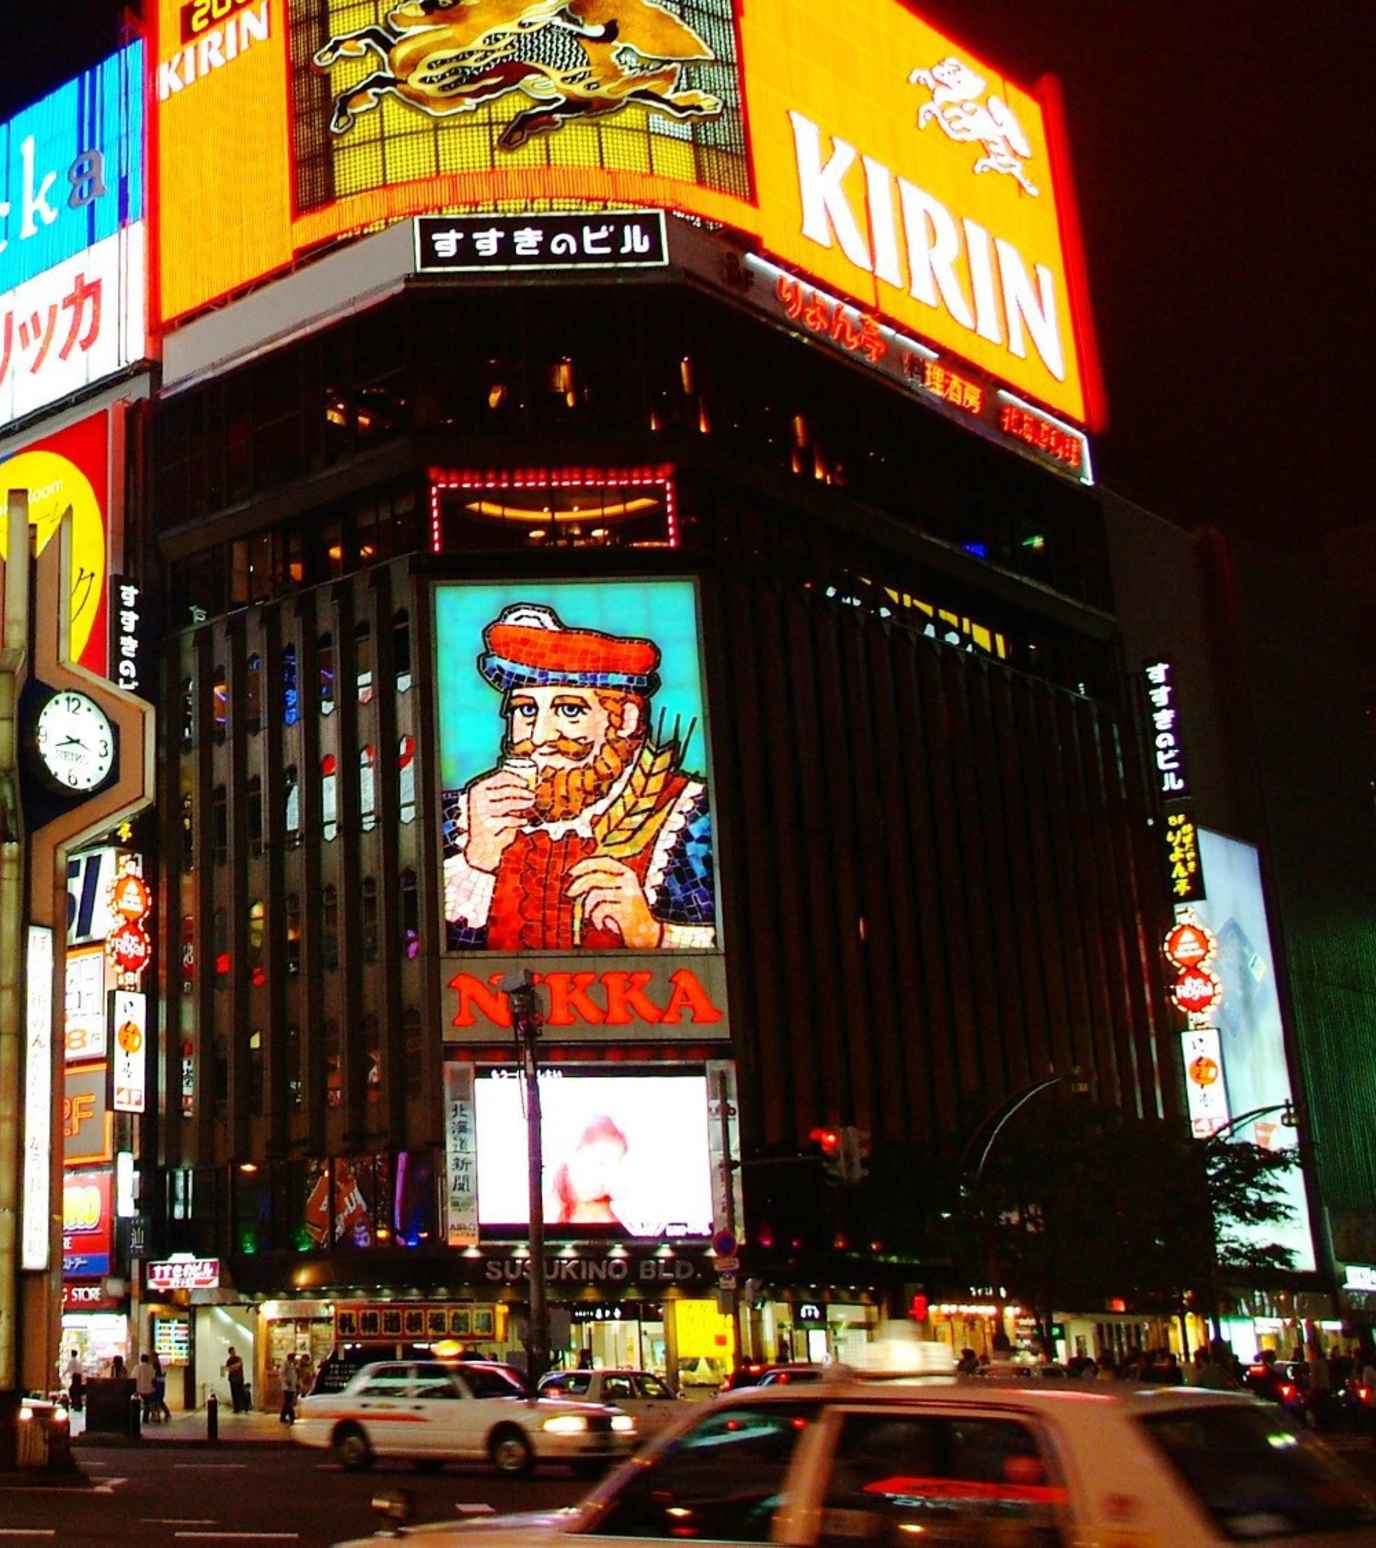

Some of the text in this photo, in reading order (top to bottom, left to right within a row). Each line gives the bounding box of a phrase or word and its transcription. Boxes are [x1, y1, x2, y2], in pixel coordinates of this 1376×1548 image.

[157, 1, 268, 101] KIRIN
[431, 224, 650, 258] すすきのビル
[787, 109, 1064, 382] KIRIN
[118, 585, 140, 690] すすきのビ
[66, 695, 81, 716] 12
[1146, 662, 1184, 791] すすきのビル
[68, 769, 78, 787] 6
[448, 969, 723, 1028] NKKA
[451, 1103, 472, 1193] 北海道新聞
[153, 1263, 214, 1279] すすきのビル
[640, 1258, 703, 1281] BLD.
[71, 1287, 101, 1302] STORE
